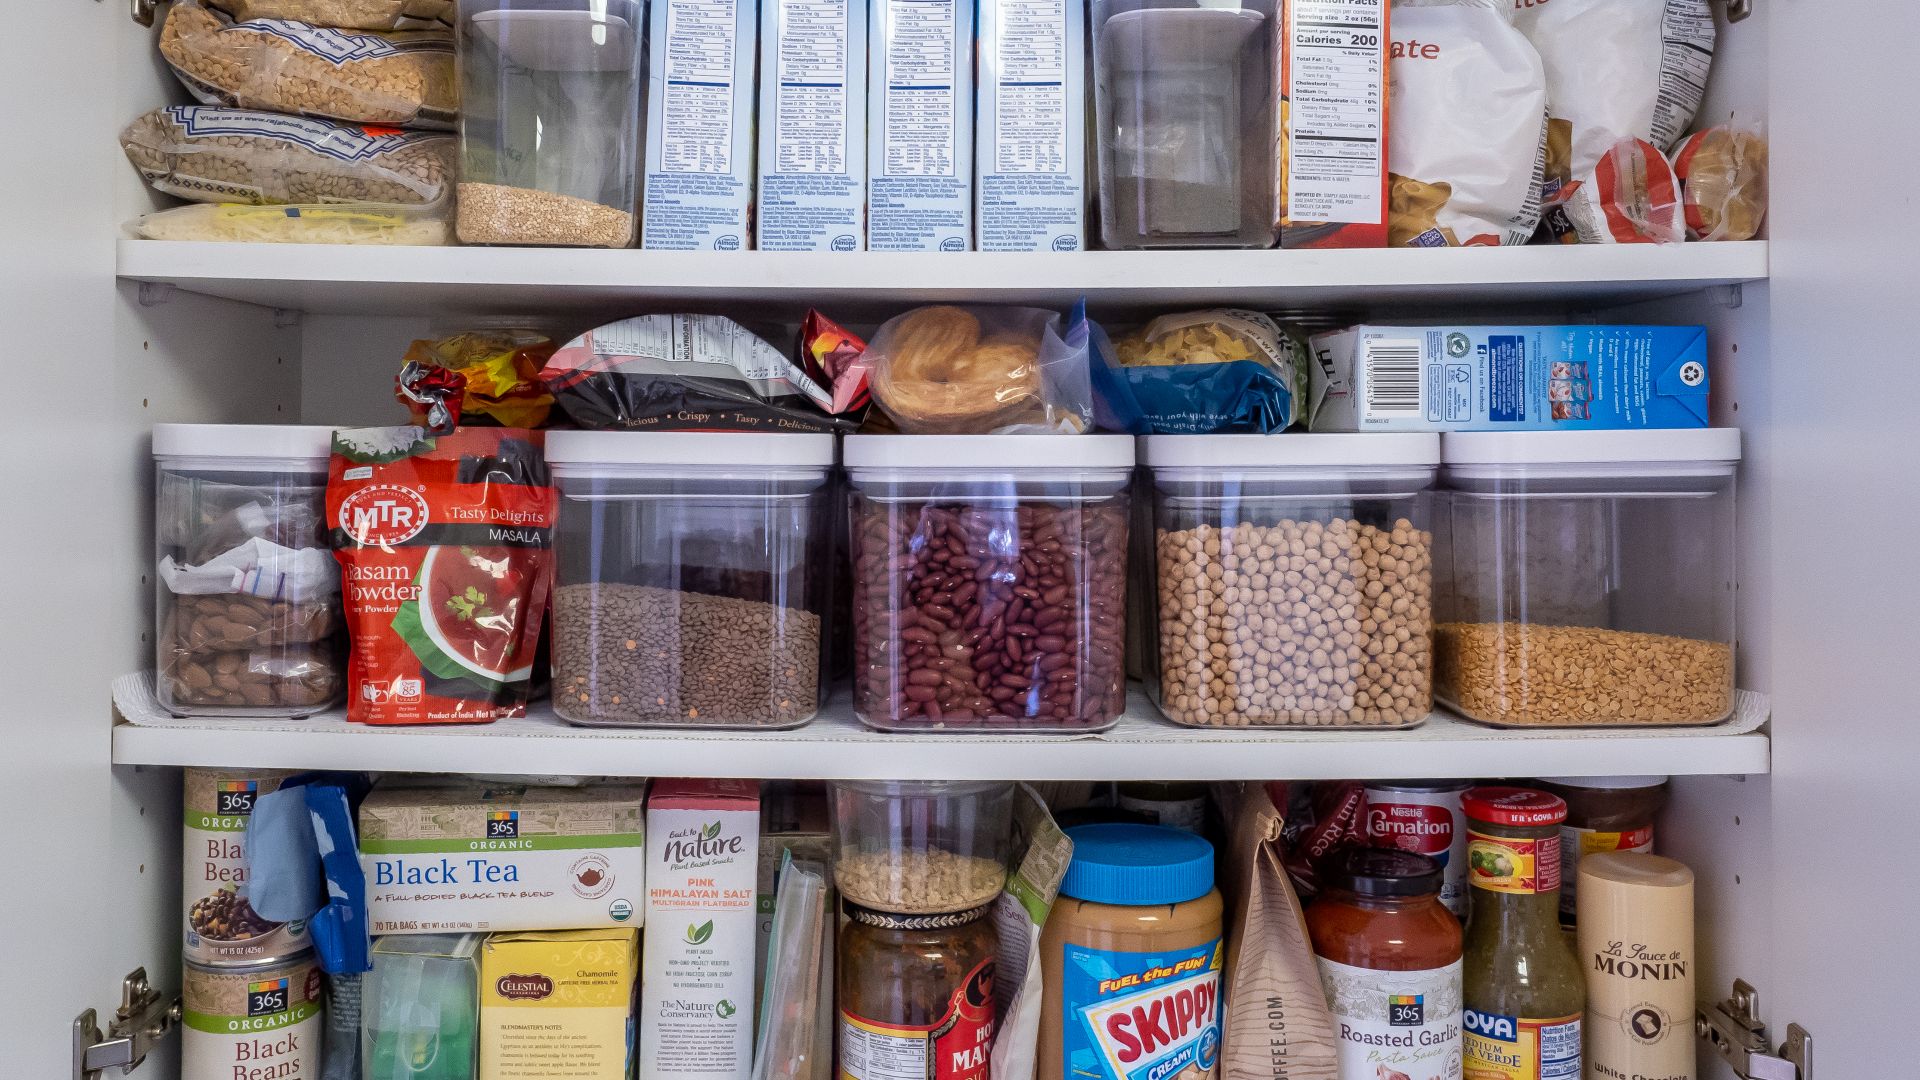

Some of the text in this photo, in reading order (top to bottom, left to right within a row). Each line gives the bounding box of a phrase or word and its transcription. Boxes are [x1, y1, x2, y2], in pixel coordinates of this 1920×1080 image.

[1296, 34, 1377, 46] Calories 200
[1262, 341, 1274, 353] WT
[678, 410, 710, 422] Crispy
[734, 413, 759, 424] Tasty
[778, 418, 822, 432] Delicious
[1166, 412, 1187, 420] your
[353, 500, 412, 528] MTR
[452, 506, 544, 524] Tasty Delights
[489, 529, 541, 543] MASALA
[402, 686, 416, 696] 85
[222, 793, 251, 810] 365
[202, 817, 246, 828] ORGA
[491, 821, 514, 835] 365
[1369, 810, 1450, 837] Carnation
[670, 828, 688, 838] Back
[1311, 822, 1343, 858] Rice
[207, 839, 242, 859] Bla
[470, 840, 533, 849] ORGANIC
[664, 832, 742, 863] nature
[375, 858, 520, 886] Black Tea
[670, 856, 734, 871] Plant Based Snacks
[687, 878, 715, 887] PINK
[650, 889, 752, 898] HIMALAYAN SALT
[400, 921, 418, 930] BAGS
[1602, 940, 1680, 961] La Sauce de
[1100, 956, 1207, 994] FUEL the FUN!
[1594, 953, 1686, 980] MONIN
[500, 980, 550, 992] CELESTIAL
[254, 992, 282, 1011] 365
[675, 1000, 715, 1011] Nature
[228, 1008, 305, 1030] ORGANIC
[660, 1009, 714, 1020] Conservancy
[1106, 979, 1217, 1063] SKIPPY
[1394, 1006, 1419, 1021] 365
[1463, 1010, 1513, 1038] OYA
[1340, 1024, 1458, 1047] Roasted Garlic
[236, 1032, 300, 1061] Black
[1148, 1046, 1193, 1080] CREAMY
[1366, 1048, 1442, 1063] Pasta Sauce
[1480, 1050, 1520, 1067] VERDE
[232, 1058, 300, 1080] Beans
[1594, 1061, 1626, 1080] White
